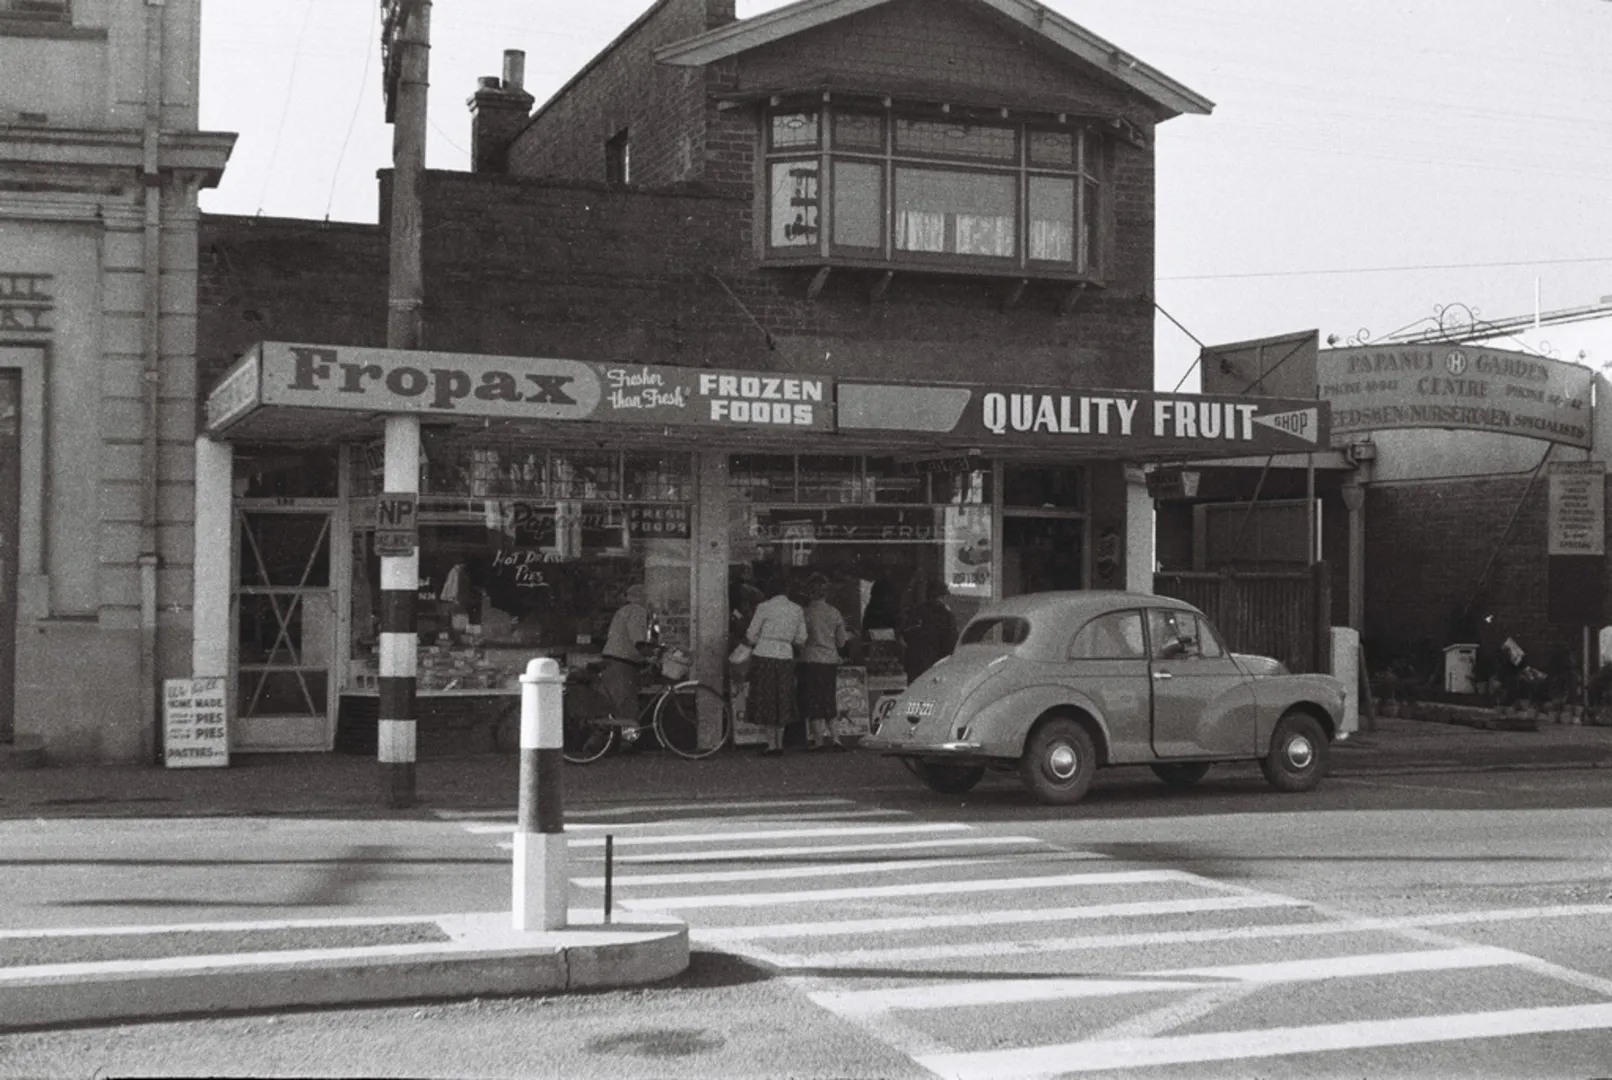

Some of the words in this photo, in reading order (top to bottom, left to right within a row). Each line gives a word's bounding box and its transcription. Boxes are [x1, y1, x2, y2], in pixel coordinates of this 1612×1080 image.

[288, 346, 577, 410] Fropax
[1347, 350, 1434, 375] PAPANUI
[1475, 354, 1550, 383] GARDEN
[699, 372, 823, 403] FROZEN
[1416, 376, 1489, 397] CENTRE
[607, 388, 643, 410] than
[710, 398, 815, 427] FOODS
[982, 391, 1138, 437] QUALITY
[1153, 399, 1258, 441] FRUIT
[1273, 411, 1308, 436] SHOP
[378, 499, 414, 526] NP
[630, 508, 686, 521] FRESH
[630, 520, 687, 534] FOODS
[195, 712, 224, 724] PIES
[195, 727, 225, 740] PIES
